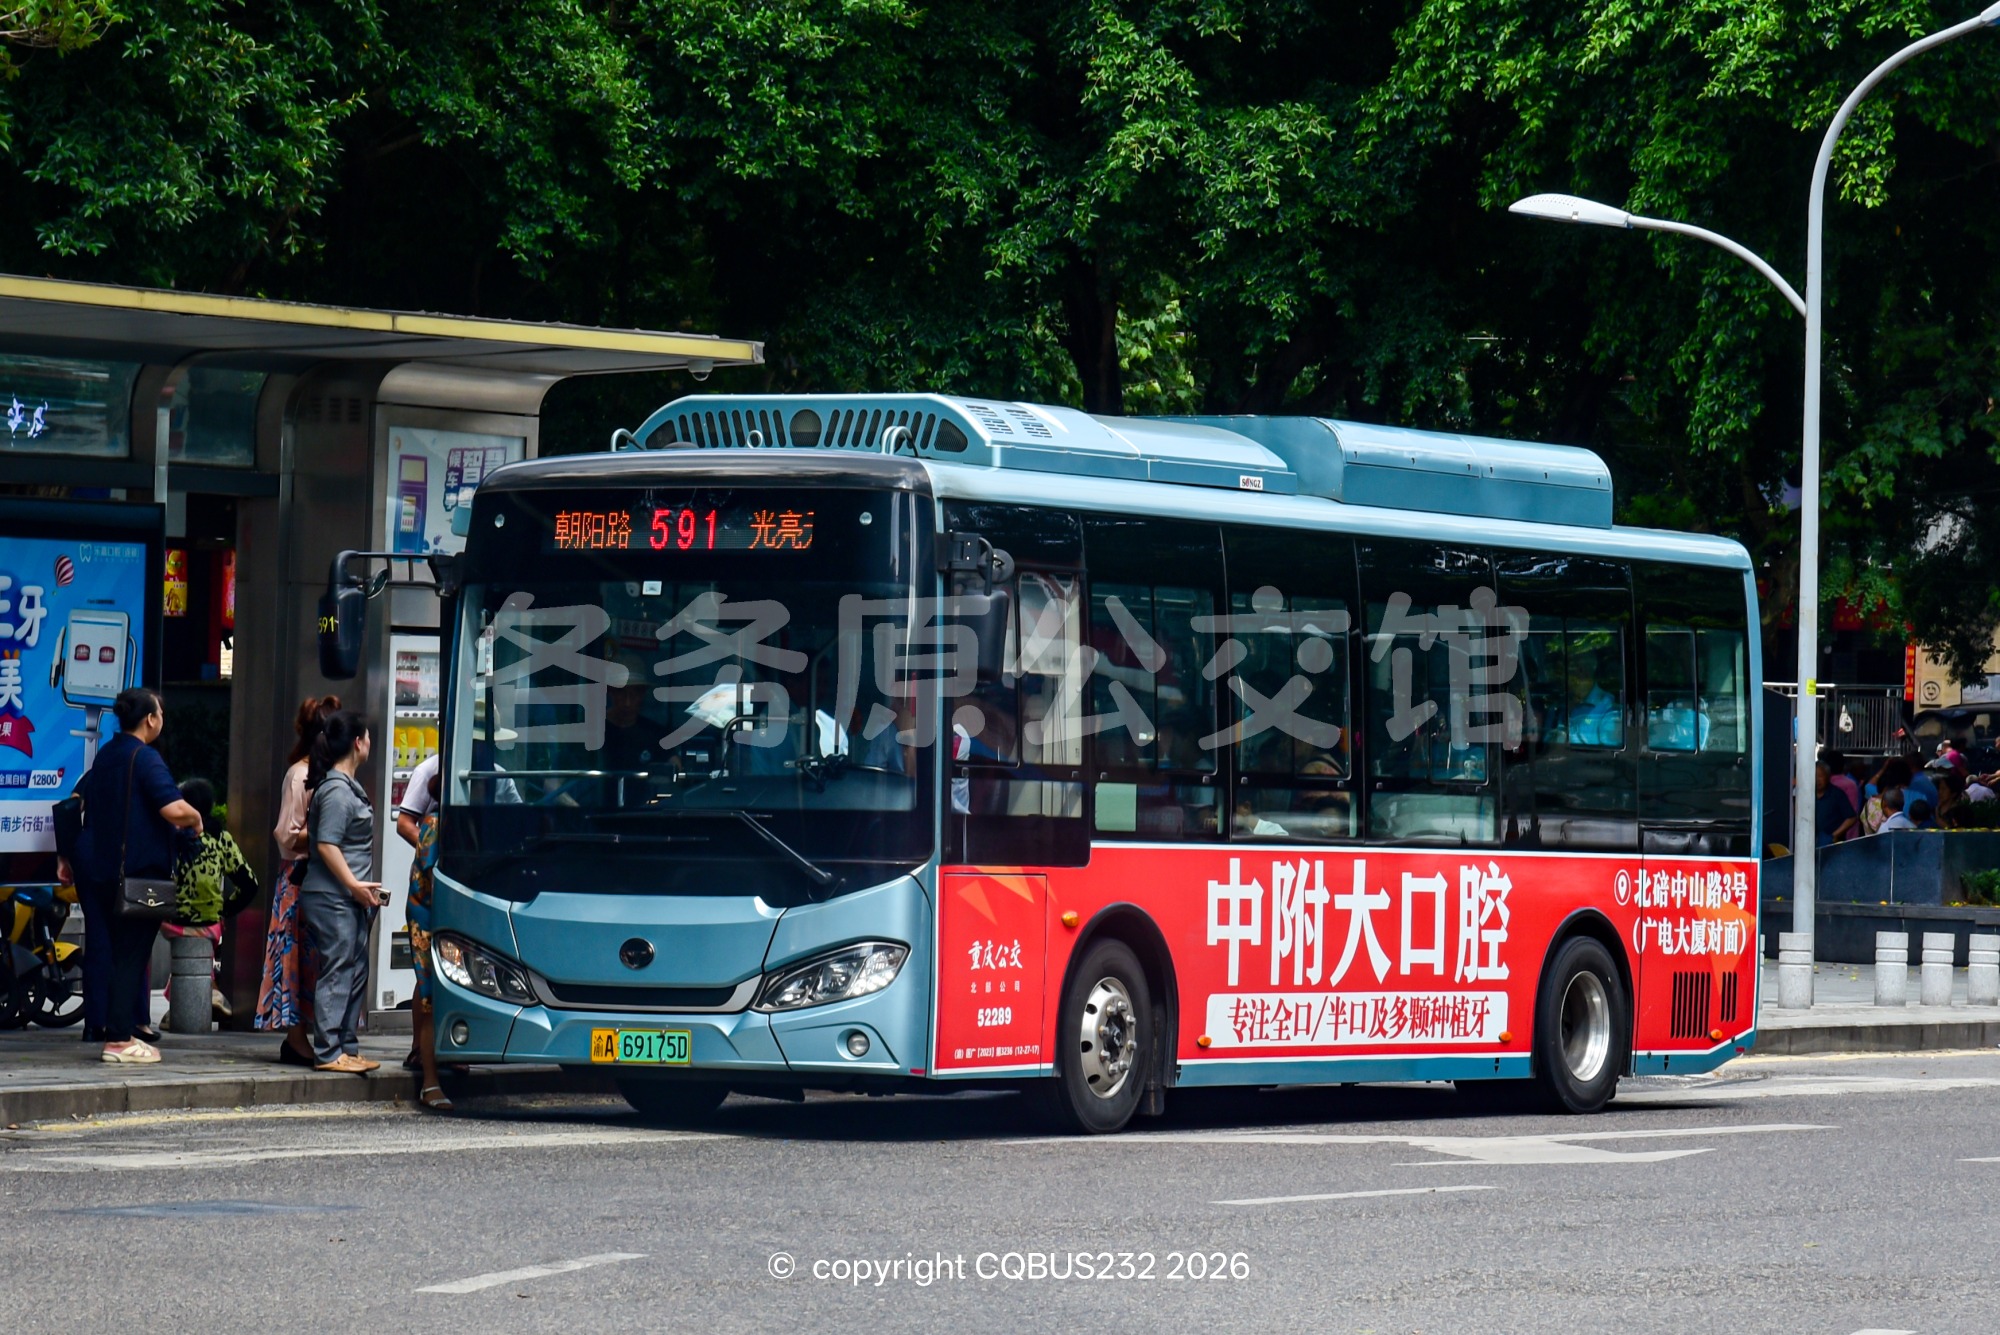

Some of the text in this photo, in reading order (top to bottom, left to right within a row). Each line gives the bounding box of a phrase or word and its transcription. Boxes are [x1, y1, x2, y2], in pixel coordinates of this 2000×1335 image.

[1241, 477, 1262, 488] SONGZ
[554, 509, 632, 549] 朝阳路
[649, 509, 717, 550] 591
[32, 774, 58, 786] 12800
[1, 816, 44, 833] 南步行街
[1633, 868, 1749, 909] 北碚中山路3号
[1206, 857, 1513, 987] 中附大口腔
[1632, 916, 1747, 955] (广电大厦对面)
[967, 939, 1023, 970] 重庆公交
[977, 1006, 1012, 1027] 52289
[1227, 995, 1491, 1043] 专注全口/半口及多颗种植牙
